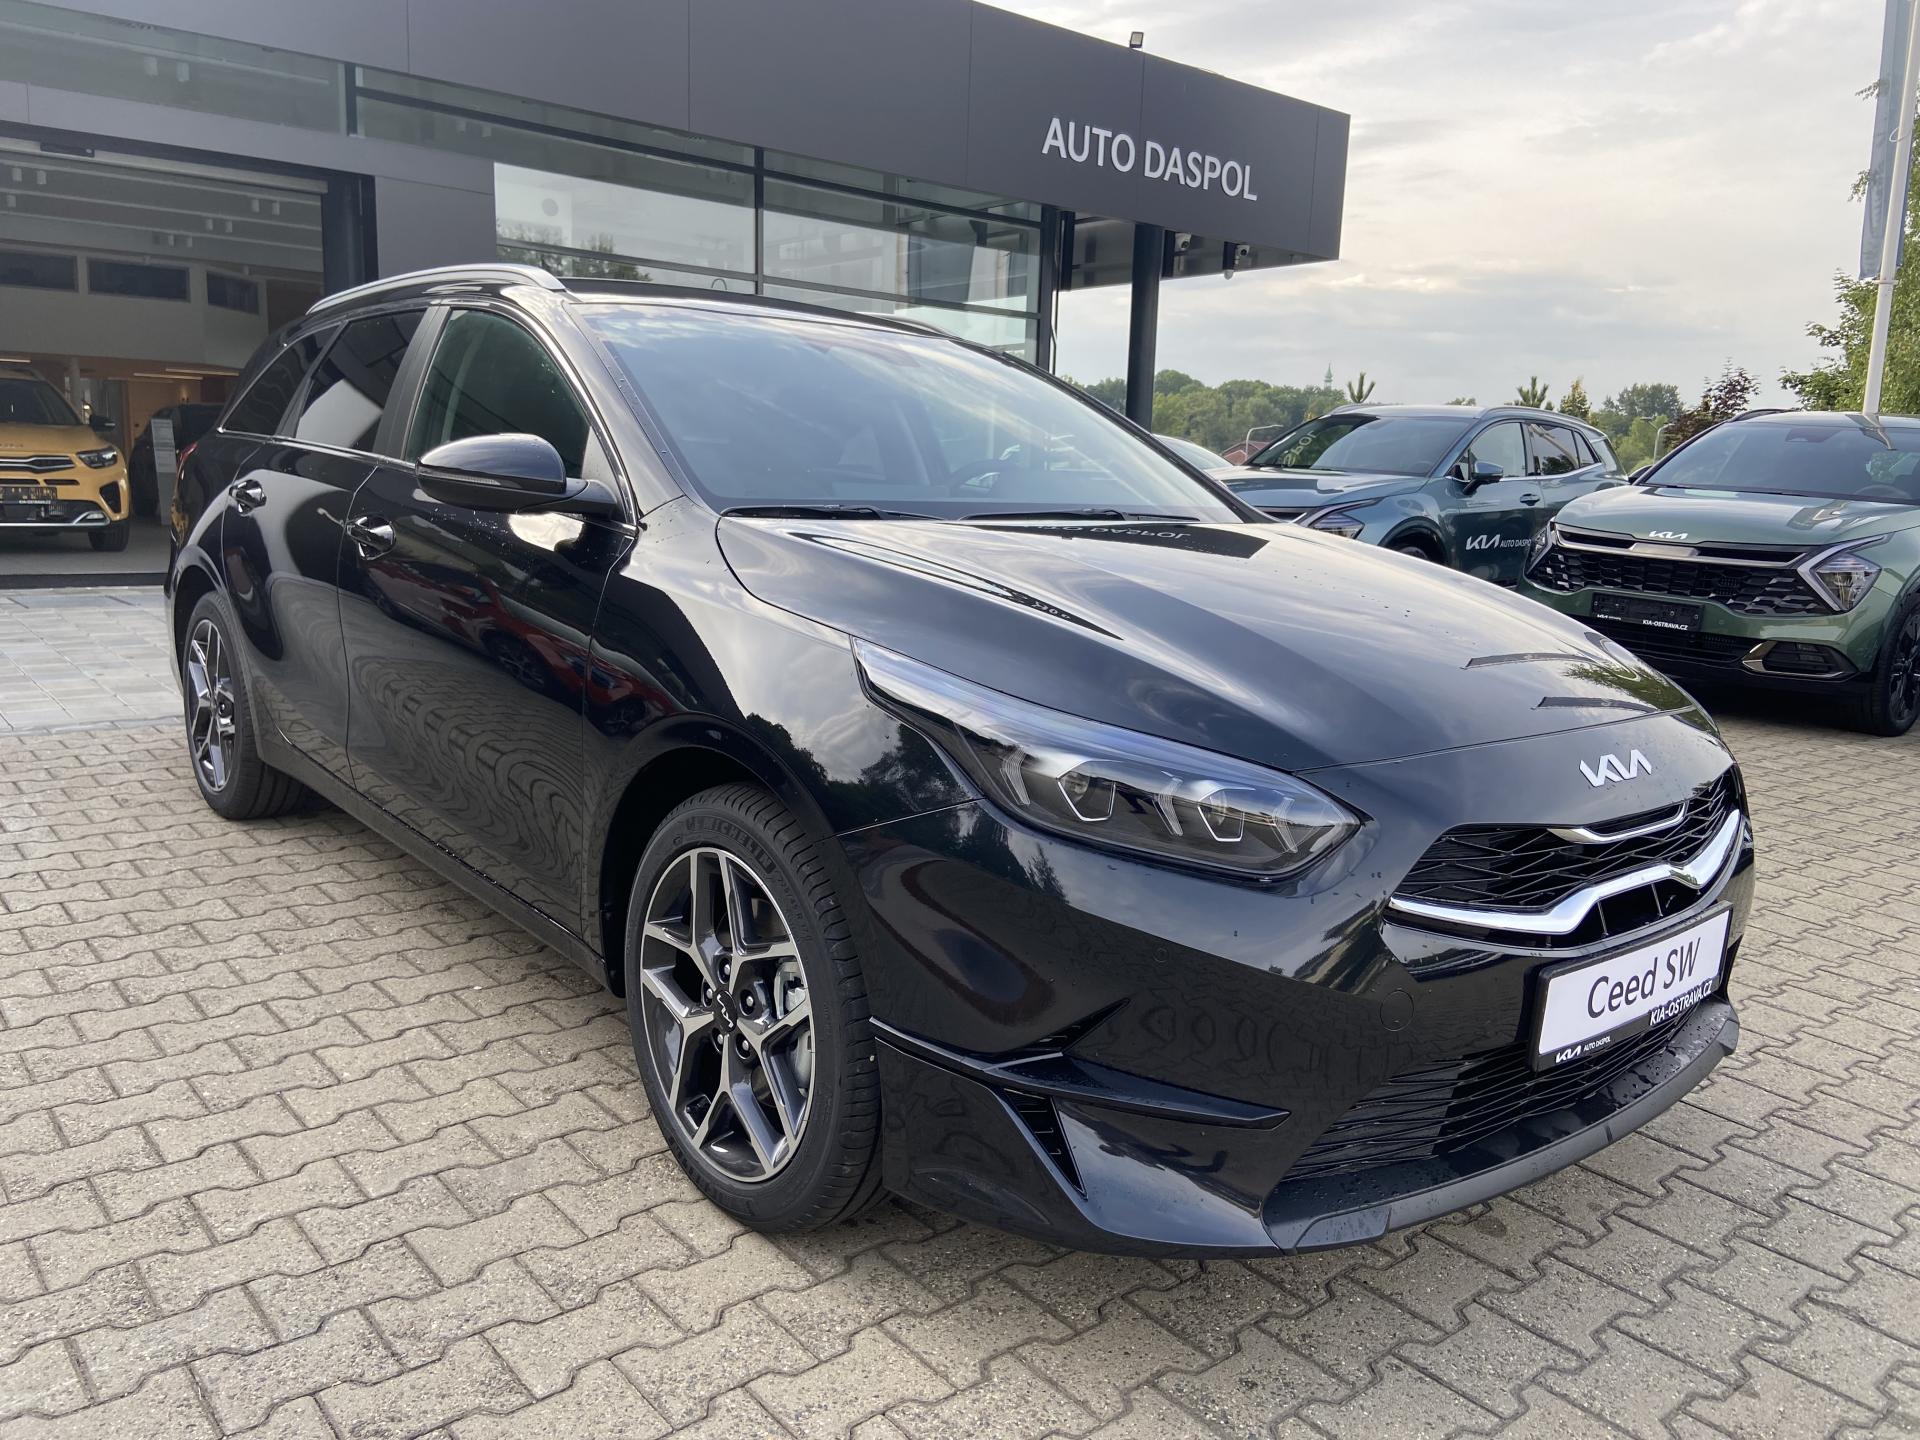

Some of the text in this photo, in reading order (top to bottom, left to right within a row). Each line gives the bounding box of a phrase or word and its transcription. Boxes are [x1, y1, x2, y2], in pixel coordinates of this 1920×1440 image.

[1042, 118, 1258, 201] AUTO DASPOL
[1466, 534, 1532, 551] KIA AUTO DASPO
[1580, 749, 1652, 788] KIA
[1587, 937, 1701, 1019] Ceed SW
[1650, 980, 1713, 1026] KIA-OSTRAVA.CZ
[1555, 1045, 1582, 1063] KIA
